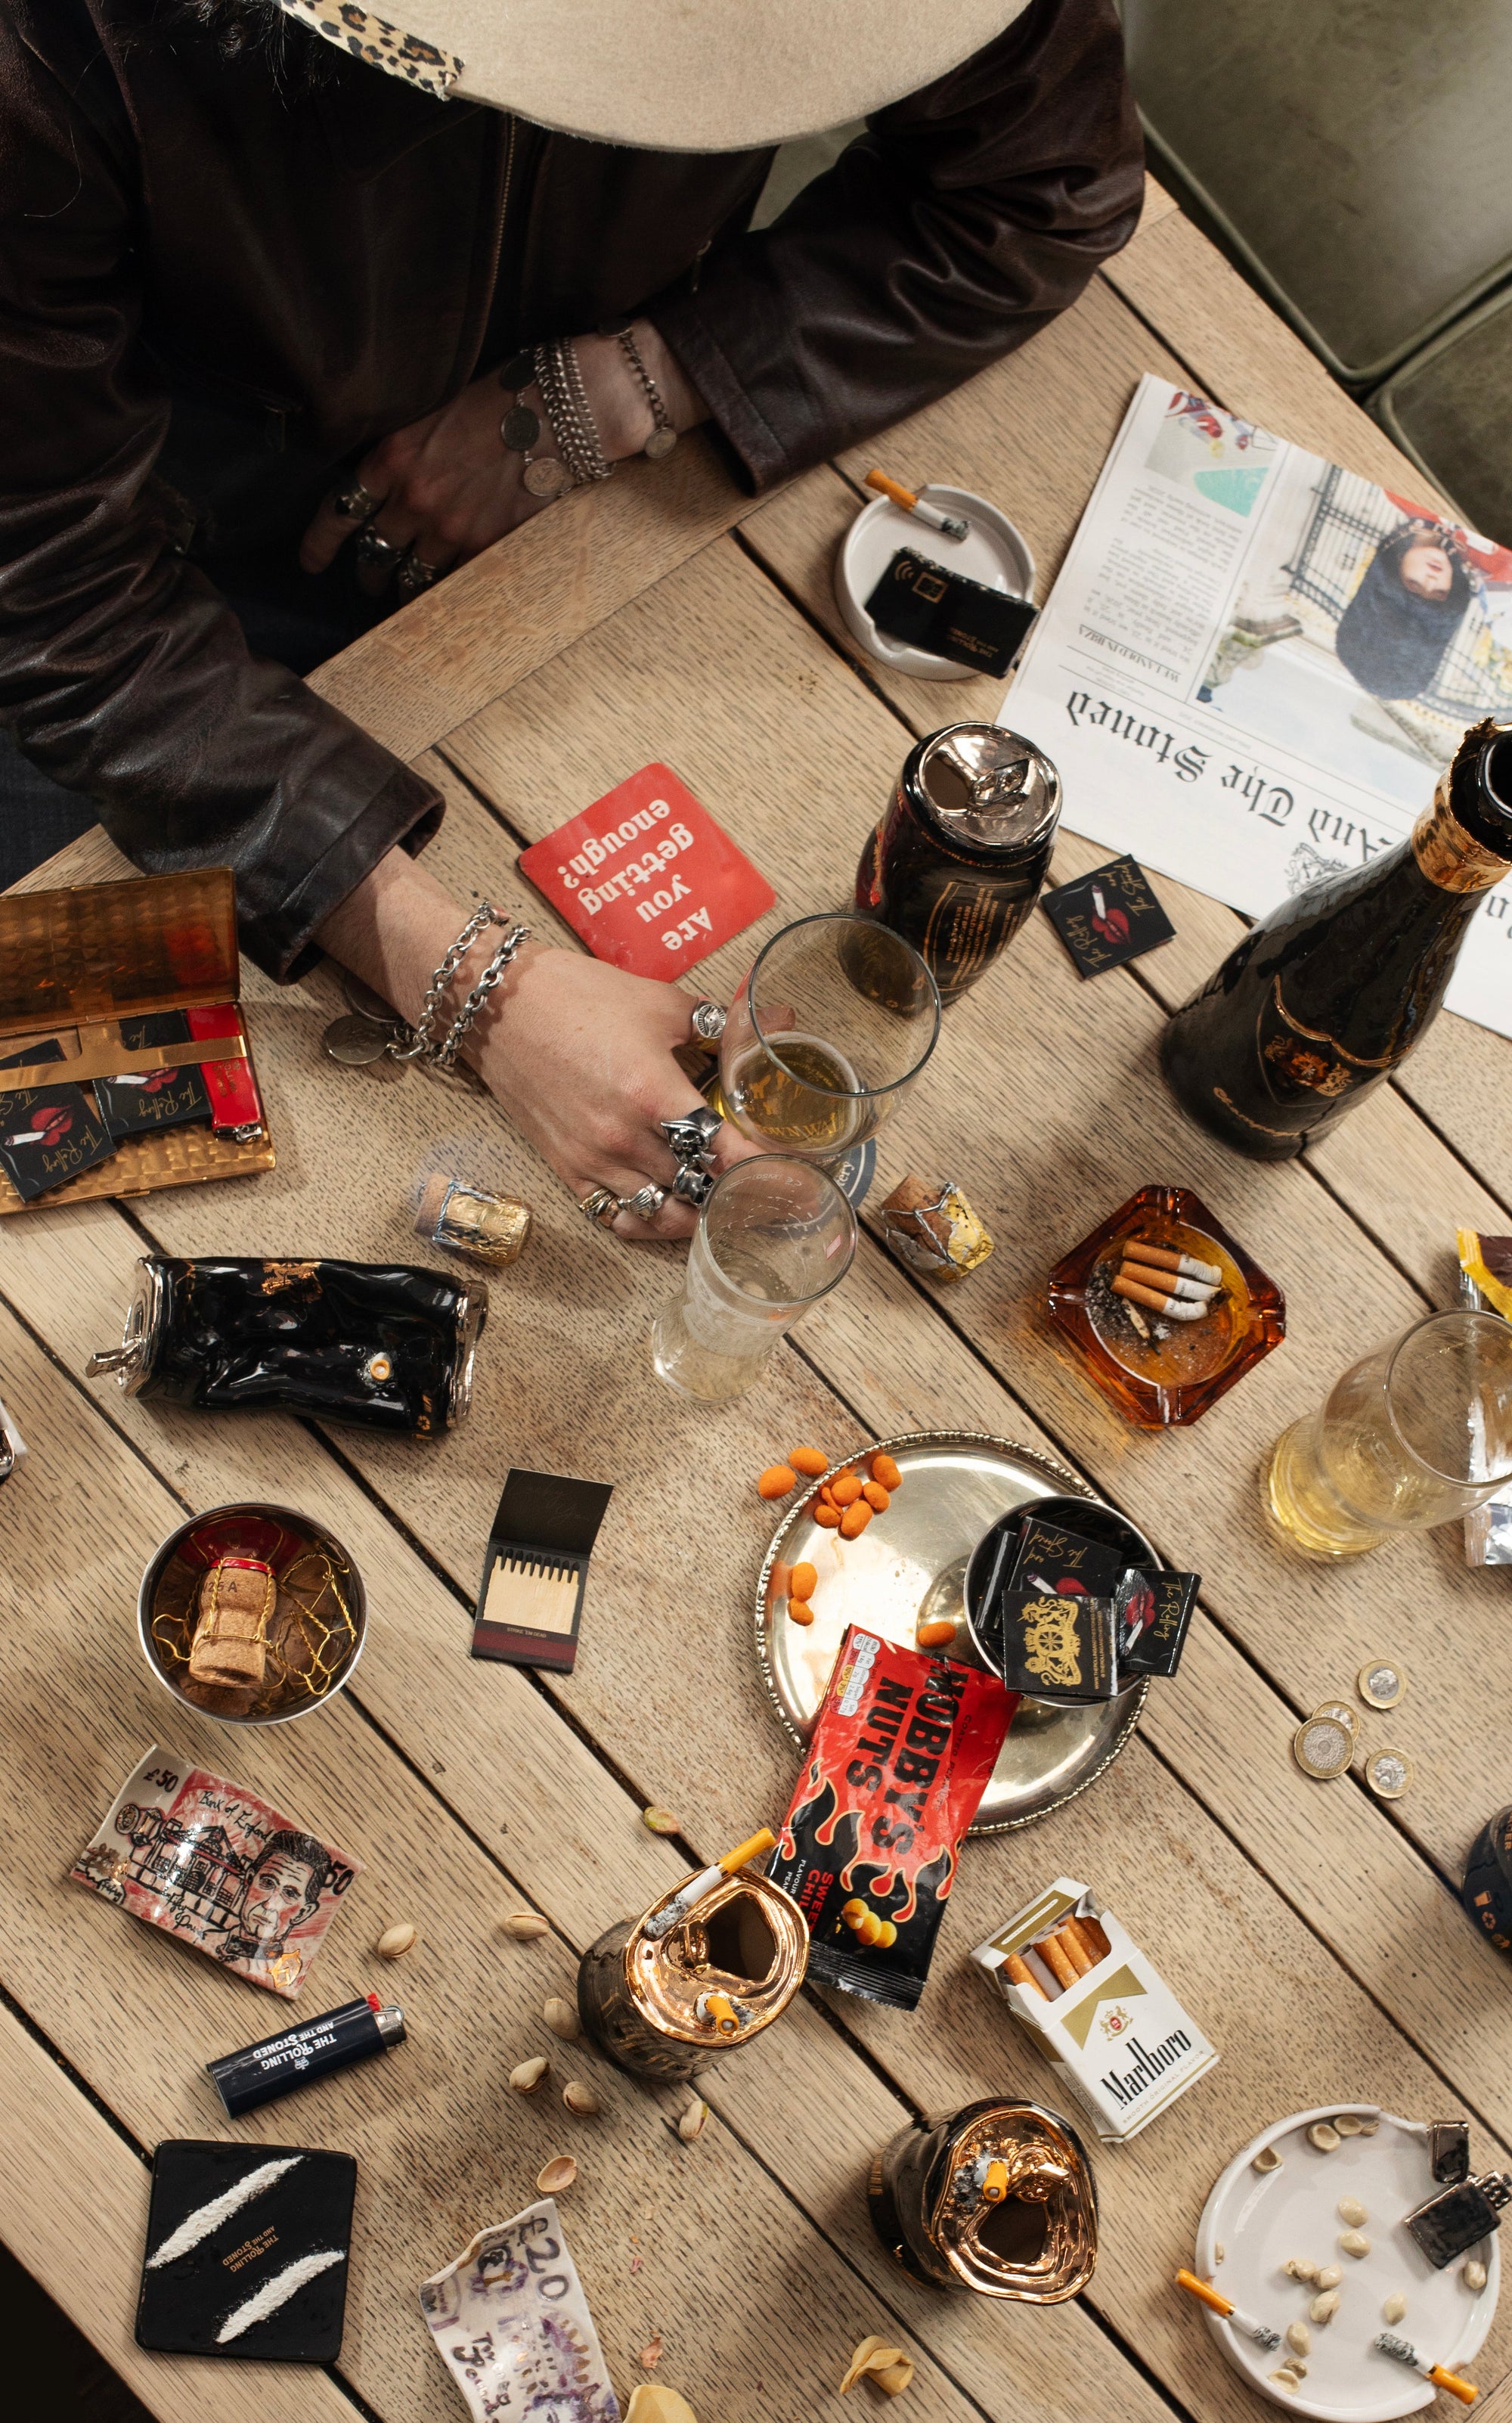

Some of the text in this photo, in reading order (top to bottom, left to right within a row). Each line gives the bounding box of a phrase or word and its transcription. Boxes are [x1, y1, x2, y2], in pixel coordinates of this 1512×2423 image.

[1067, 689, 1392, 862] And The Stoned
[556, 798, 667, 888] enough?
[578, 822, 694, 915] getting
[1113, 863, 1154, 916] The Stoned
[635, 873, 691, 923] you
[660, 905, 712, 949] Are
[1065, 914, 1111, 968] The Rolling
[138, 1081, 202, 1119] The Rolling
[42, 1125, 102, 1172] The Rolling
[1023, 1546, 1043, 1564] and
[1027, 1527, 1087, 1567] The Stoned
[1153, 1578, 1182, 1640] The Rolling
[845, 1676, 914, 1792] NUTS
[951, 1714, 972, 1757] COATED
[143, 1769, 179, 1793] £50
[870, 1663, 969, 1857] NOBBY'S
[321, 1859, 356, 1897] 50
[789, 1858, 806, 1894] FLAVOUR
[796, 1867, 822, 1911] CHIL
[804, 1870, 835, 1934] SWEET
[252, 2021, 334, 2059] AND THE STONED
[261, 2033, 337, 2071] THE ROLLING
[1099, 2028, 1193, 2111] Marlboro
[1123, 2099, 1150, 2125] SMOOTH
[1148, 2071, 1179, 2100] ORIGINAL
[222, 2225, 274, 2266] AND THE STONED
[229, 2234, 279, 2273] THE ROLLING
[519, 2216, 568, 2300] £20
